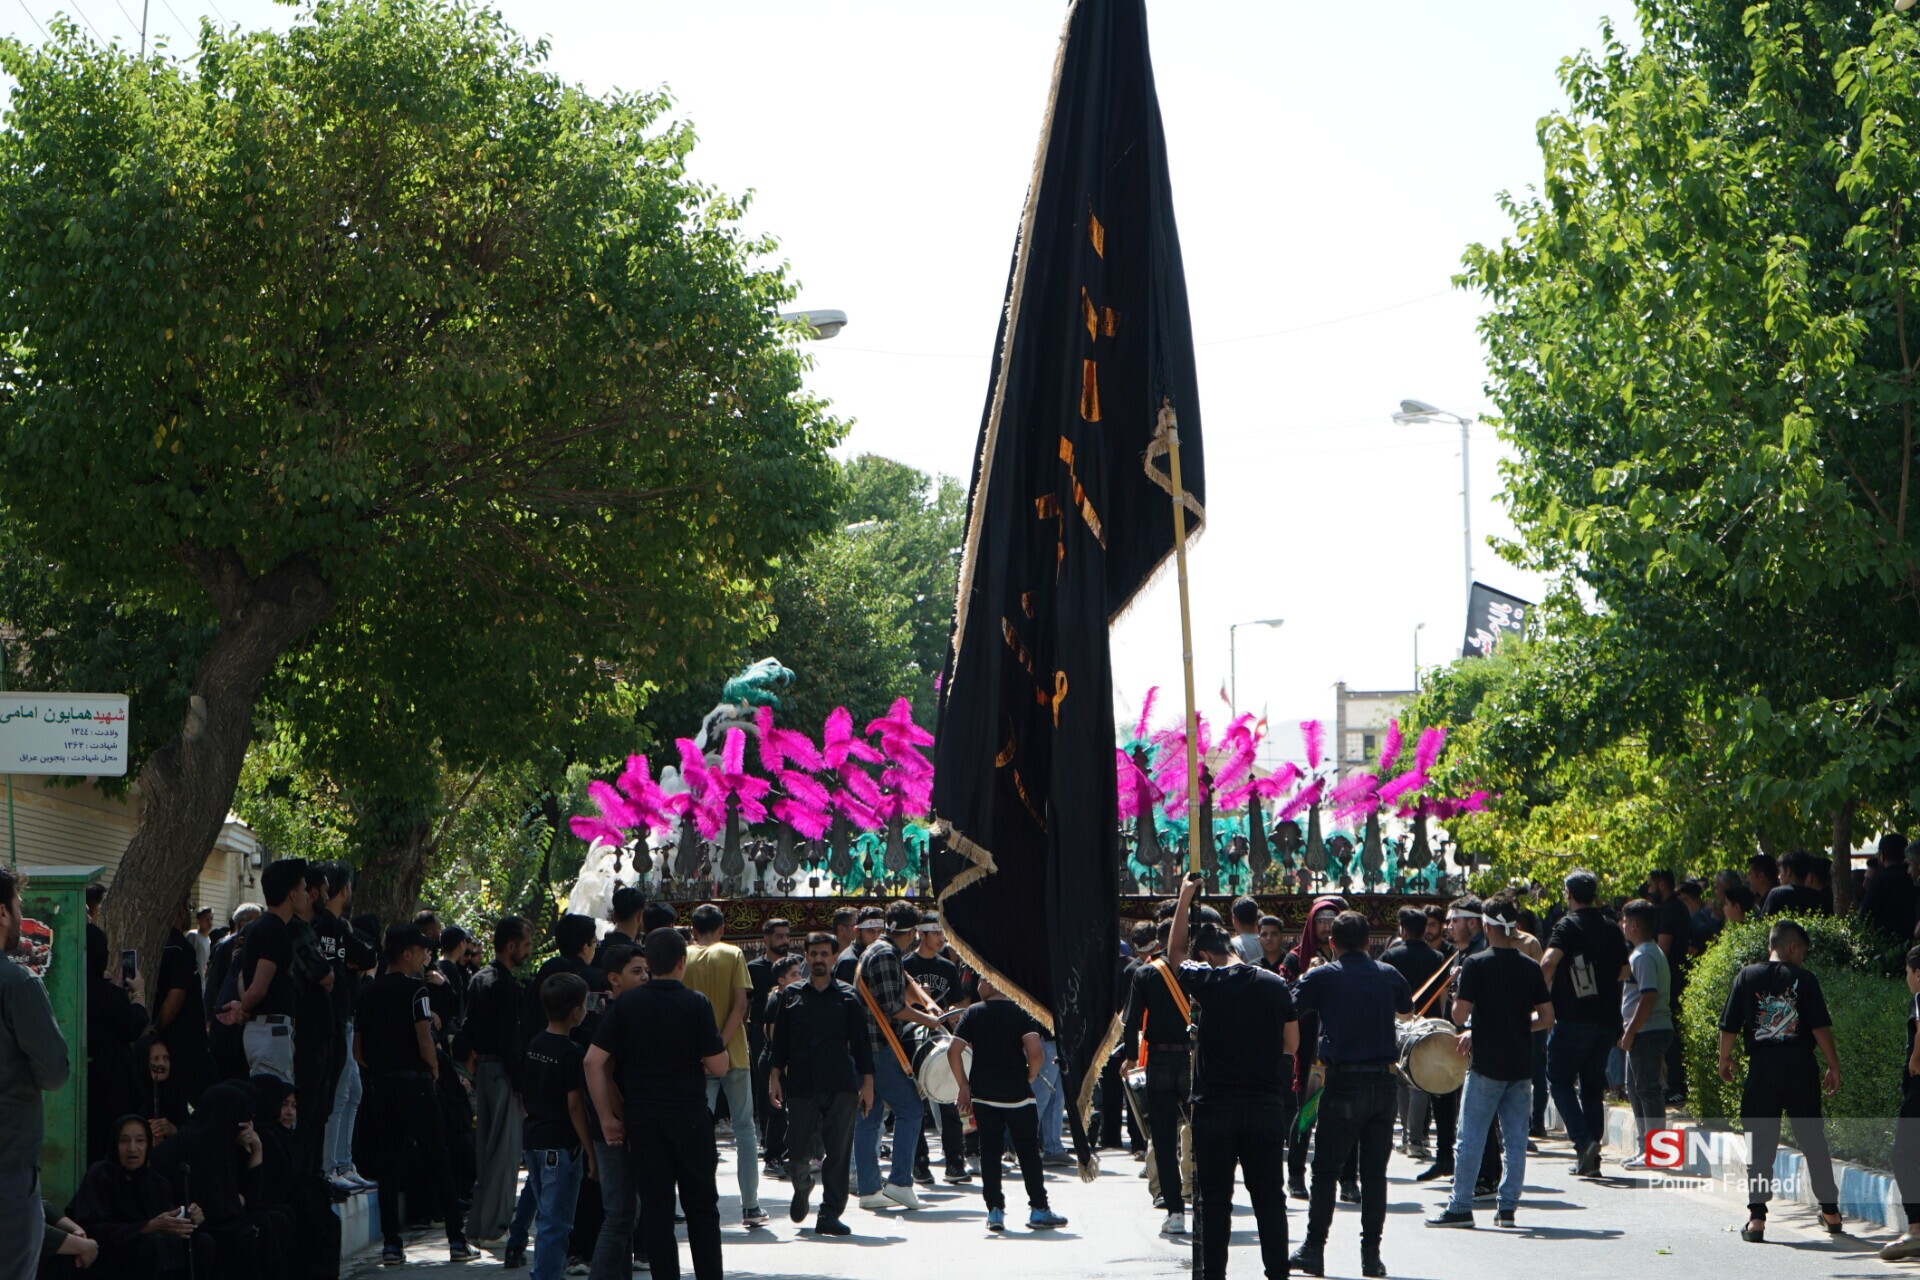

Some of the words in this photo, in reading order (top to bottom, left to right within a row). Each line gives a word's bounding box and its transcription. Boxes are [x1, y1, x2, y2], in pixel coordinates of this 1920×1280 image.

[0, 705, 37, 724] امامی
[44, 706, 92, 724] همایون
[93, 708, 125, 725] شهید
